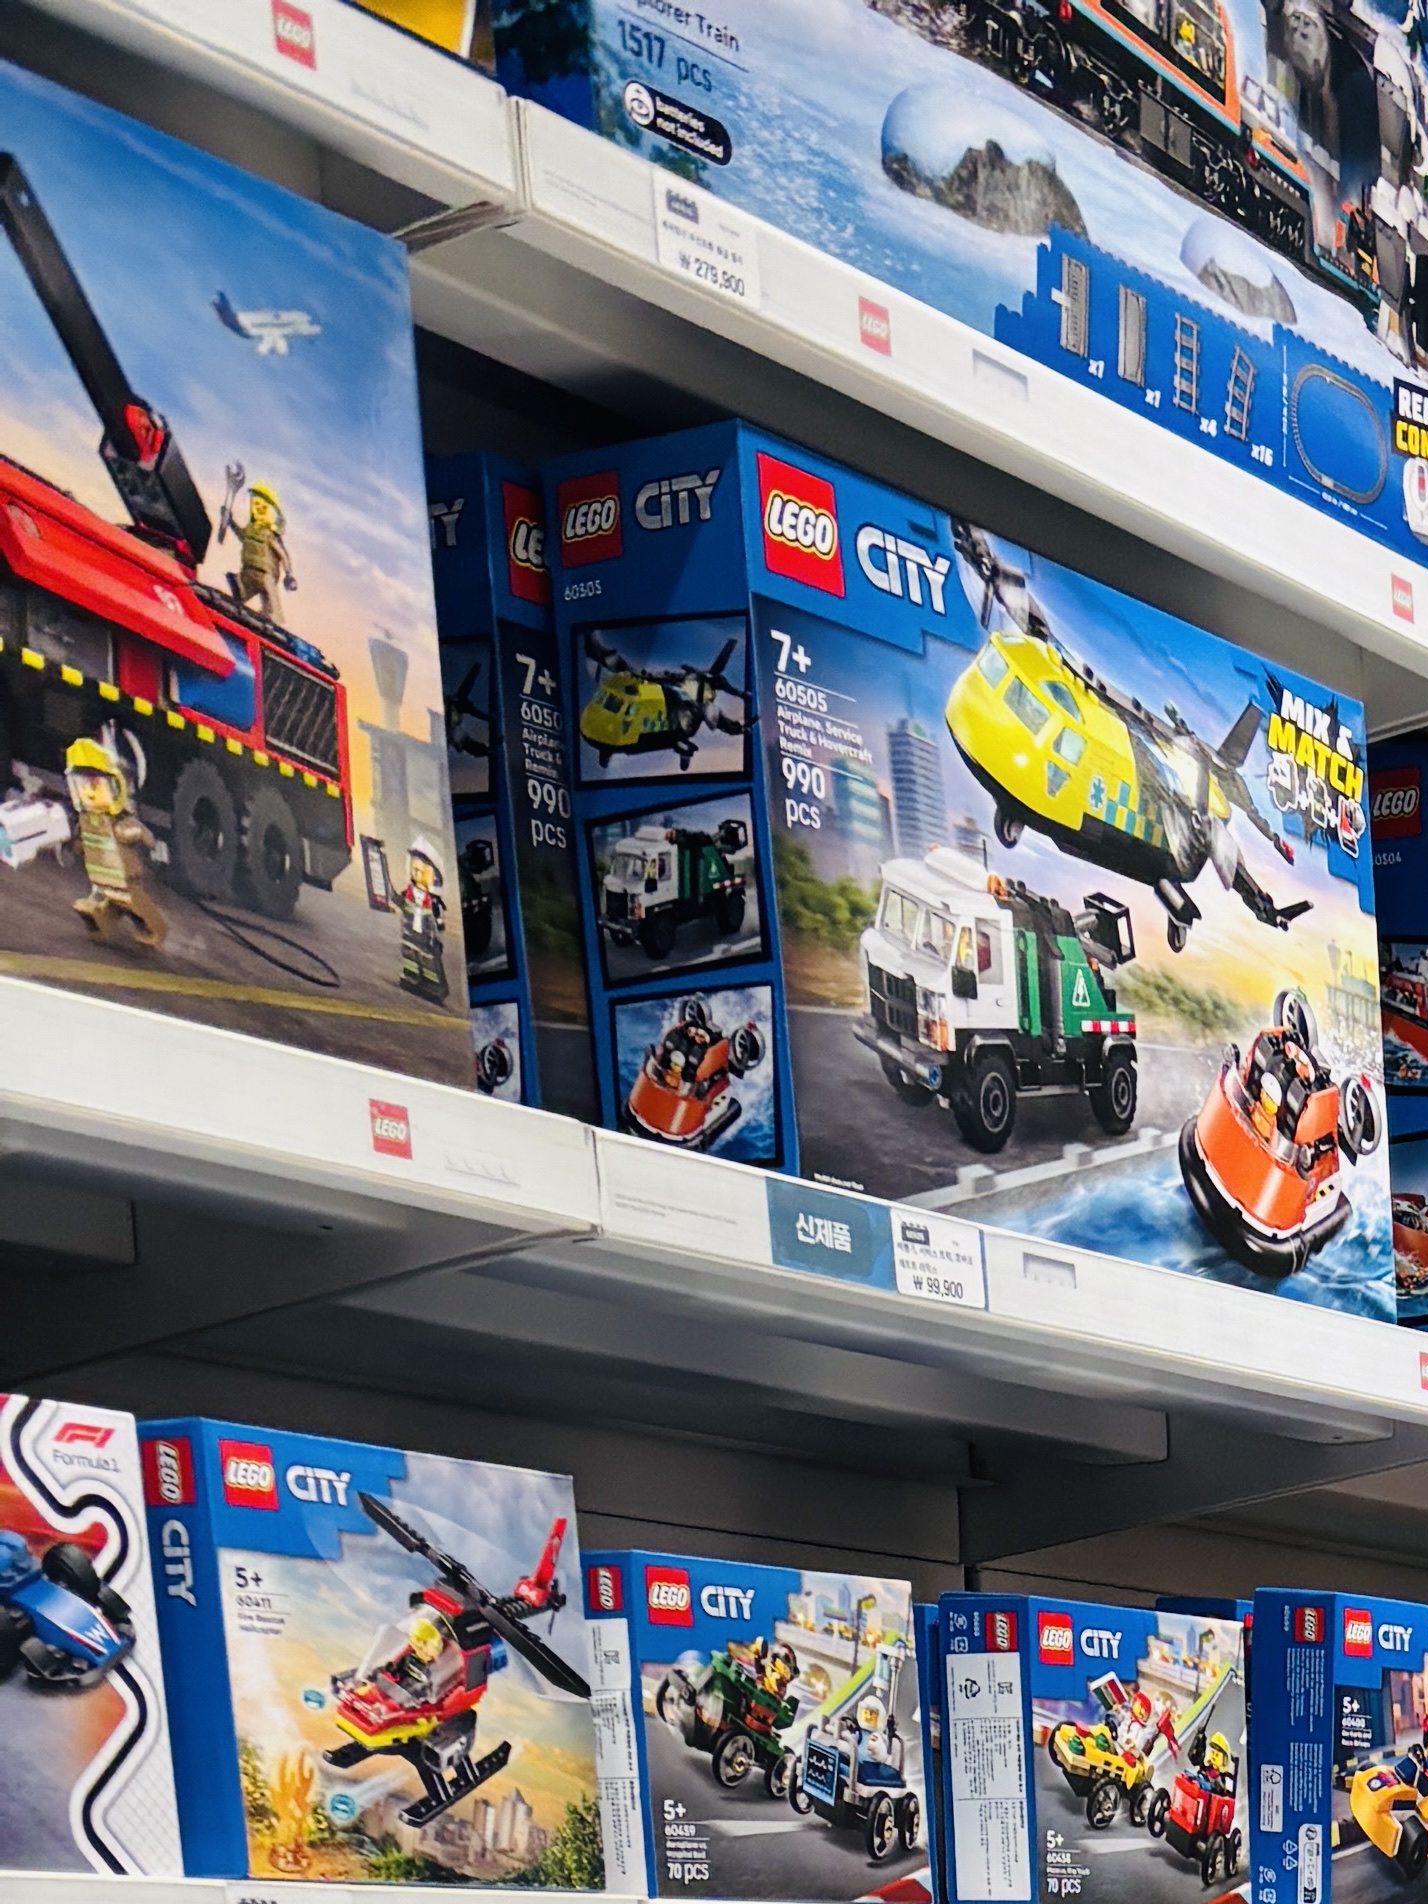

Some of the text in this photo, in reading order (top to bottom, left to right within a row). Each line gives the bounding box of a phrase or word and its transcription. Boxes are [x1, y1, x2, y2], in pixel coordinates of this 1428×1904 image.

[696, 12, 740, 52] Train
[617, 19, 713, 94] 1517 pcs
[563, 470, 722, 541] LEGO CITY
[765, 490, 952, 615] LEGO CITY
[770, 630, 812, 674] 7+
[516, 653, 557, 697] 7+
[775, 677, 829, 714] 60505
[1280, 688, 1331, 737] MIX
[778, 720, 808, 743] Truck
[780, 737, 813, 760] Remix
[1268, 714, 1365, 802] MATCH
[782, 758, 827, 800] 990
[527, 780, 571, 819] 990
[786, 796, 821, 830] pcs
[1371, 783, 1421, 821] LEGO
[531, 816, 568, 850] pcs
[374, 1112, 408, 1141] LEGO
[796, 1211, 852, 1255] 신제품
[926, 1276, 965, 1300] 99,900
[226, 1458, 352, 1507] LEGO CITY
[160, 1441, 196, 1607] LEGO CITY
[234, 1566, 264, 1591] 5+
[648, 1583, 756, 1621] LEGO CITY
[1040, 1624, 1123, 1660] LEGO CITY
[1344, 1621, 1413, 1653] LEGO CITY
[1342, 1696, 1361, 1715] 5+
[664, 1800, 687, 1821] 5+
[1046, 1829, 1065, 1848] 5+
[666, 1861, 710, 1884] 70 pcs
[1046, 1877, 1082, 1900] 70 pcs
